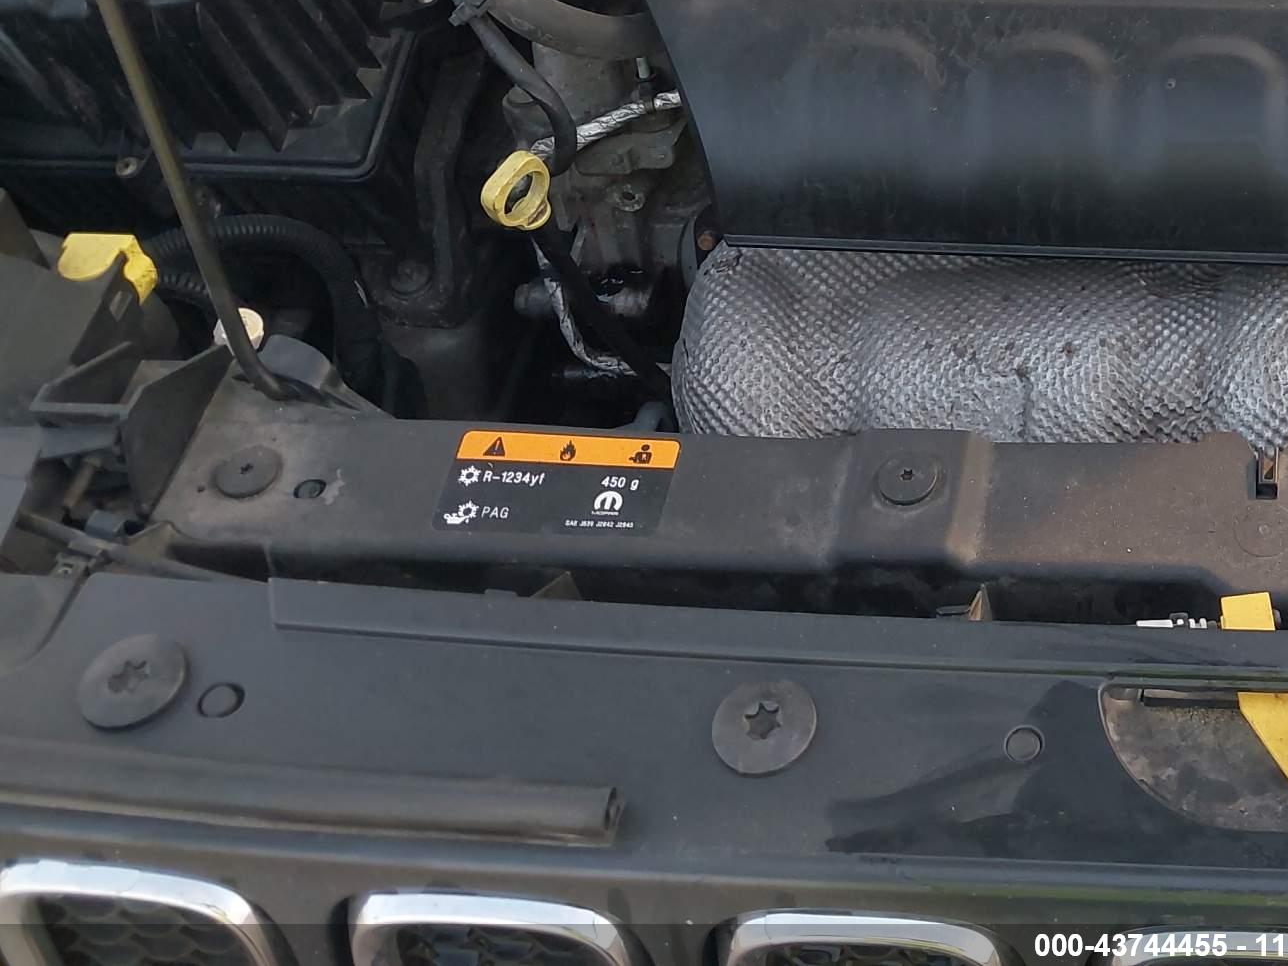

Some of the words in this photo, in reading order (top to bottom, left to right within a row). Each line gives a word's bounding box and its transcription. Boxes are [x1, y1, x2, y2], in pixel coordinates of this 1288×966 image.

[482, 470, 545, 487] R-1234yf
[600, 476, 626, 488] 450
[630, 479, 640, 491] g
[480, 506, 510, 519] PAG
